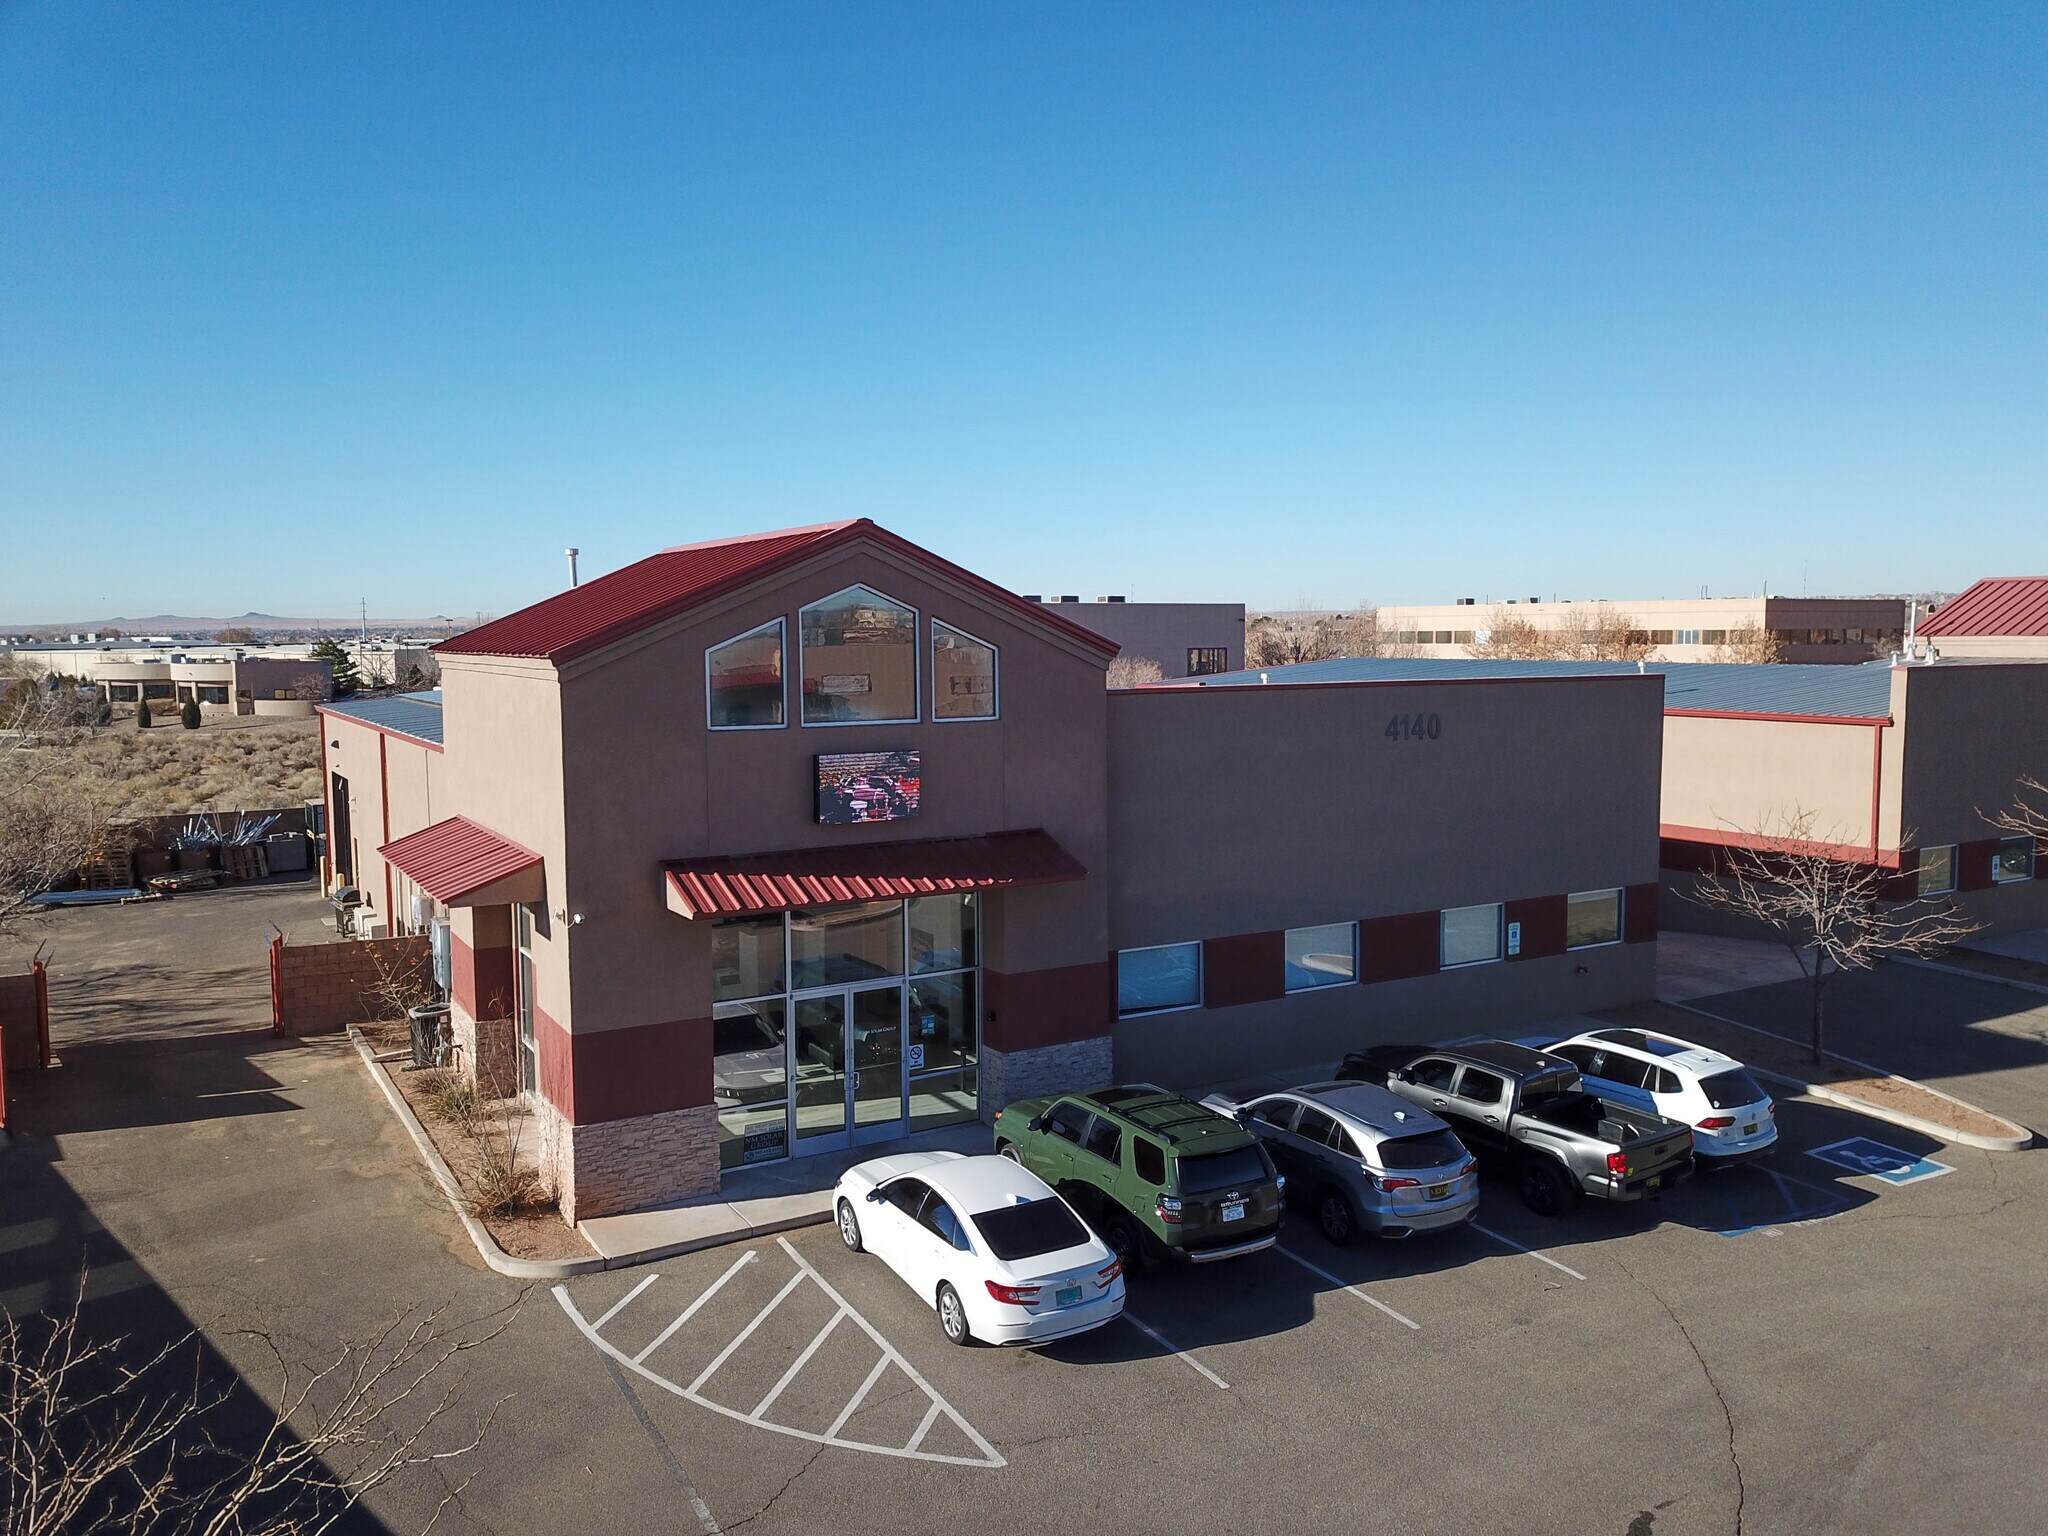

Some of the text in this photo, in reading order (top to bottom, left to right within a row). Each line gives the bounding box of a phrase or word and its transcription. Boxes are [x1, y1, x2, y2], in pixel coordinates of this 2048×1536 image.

[1384, 713, 1442, 742] 4140
[746, 1132, 784, 1144] NM SOLAR
[750, 1139, 779, 1149] GROUP
